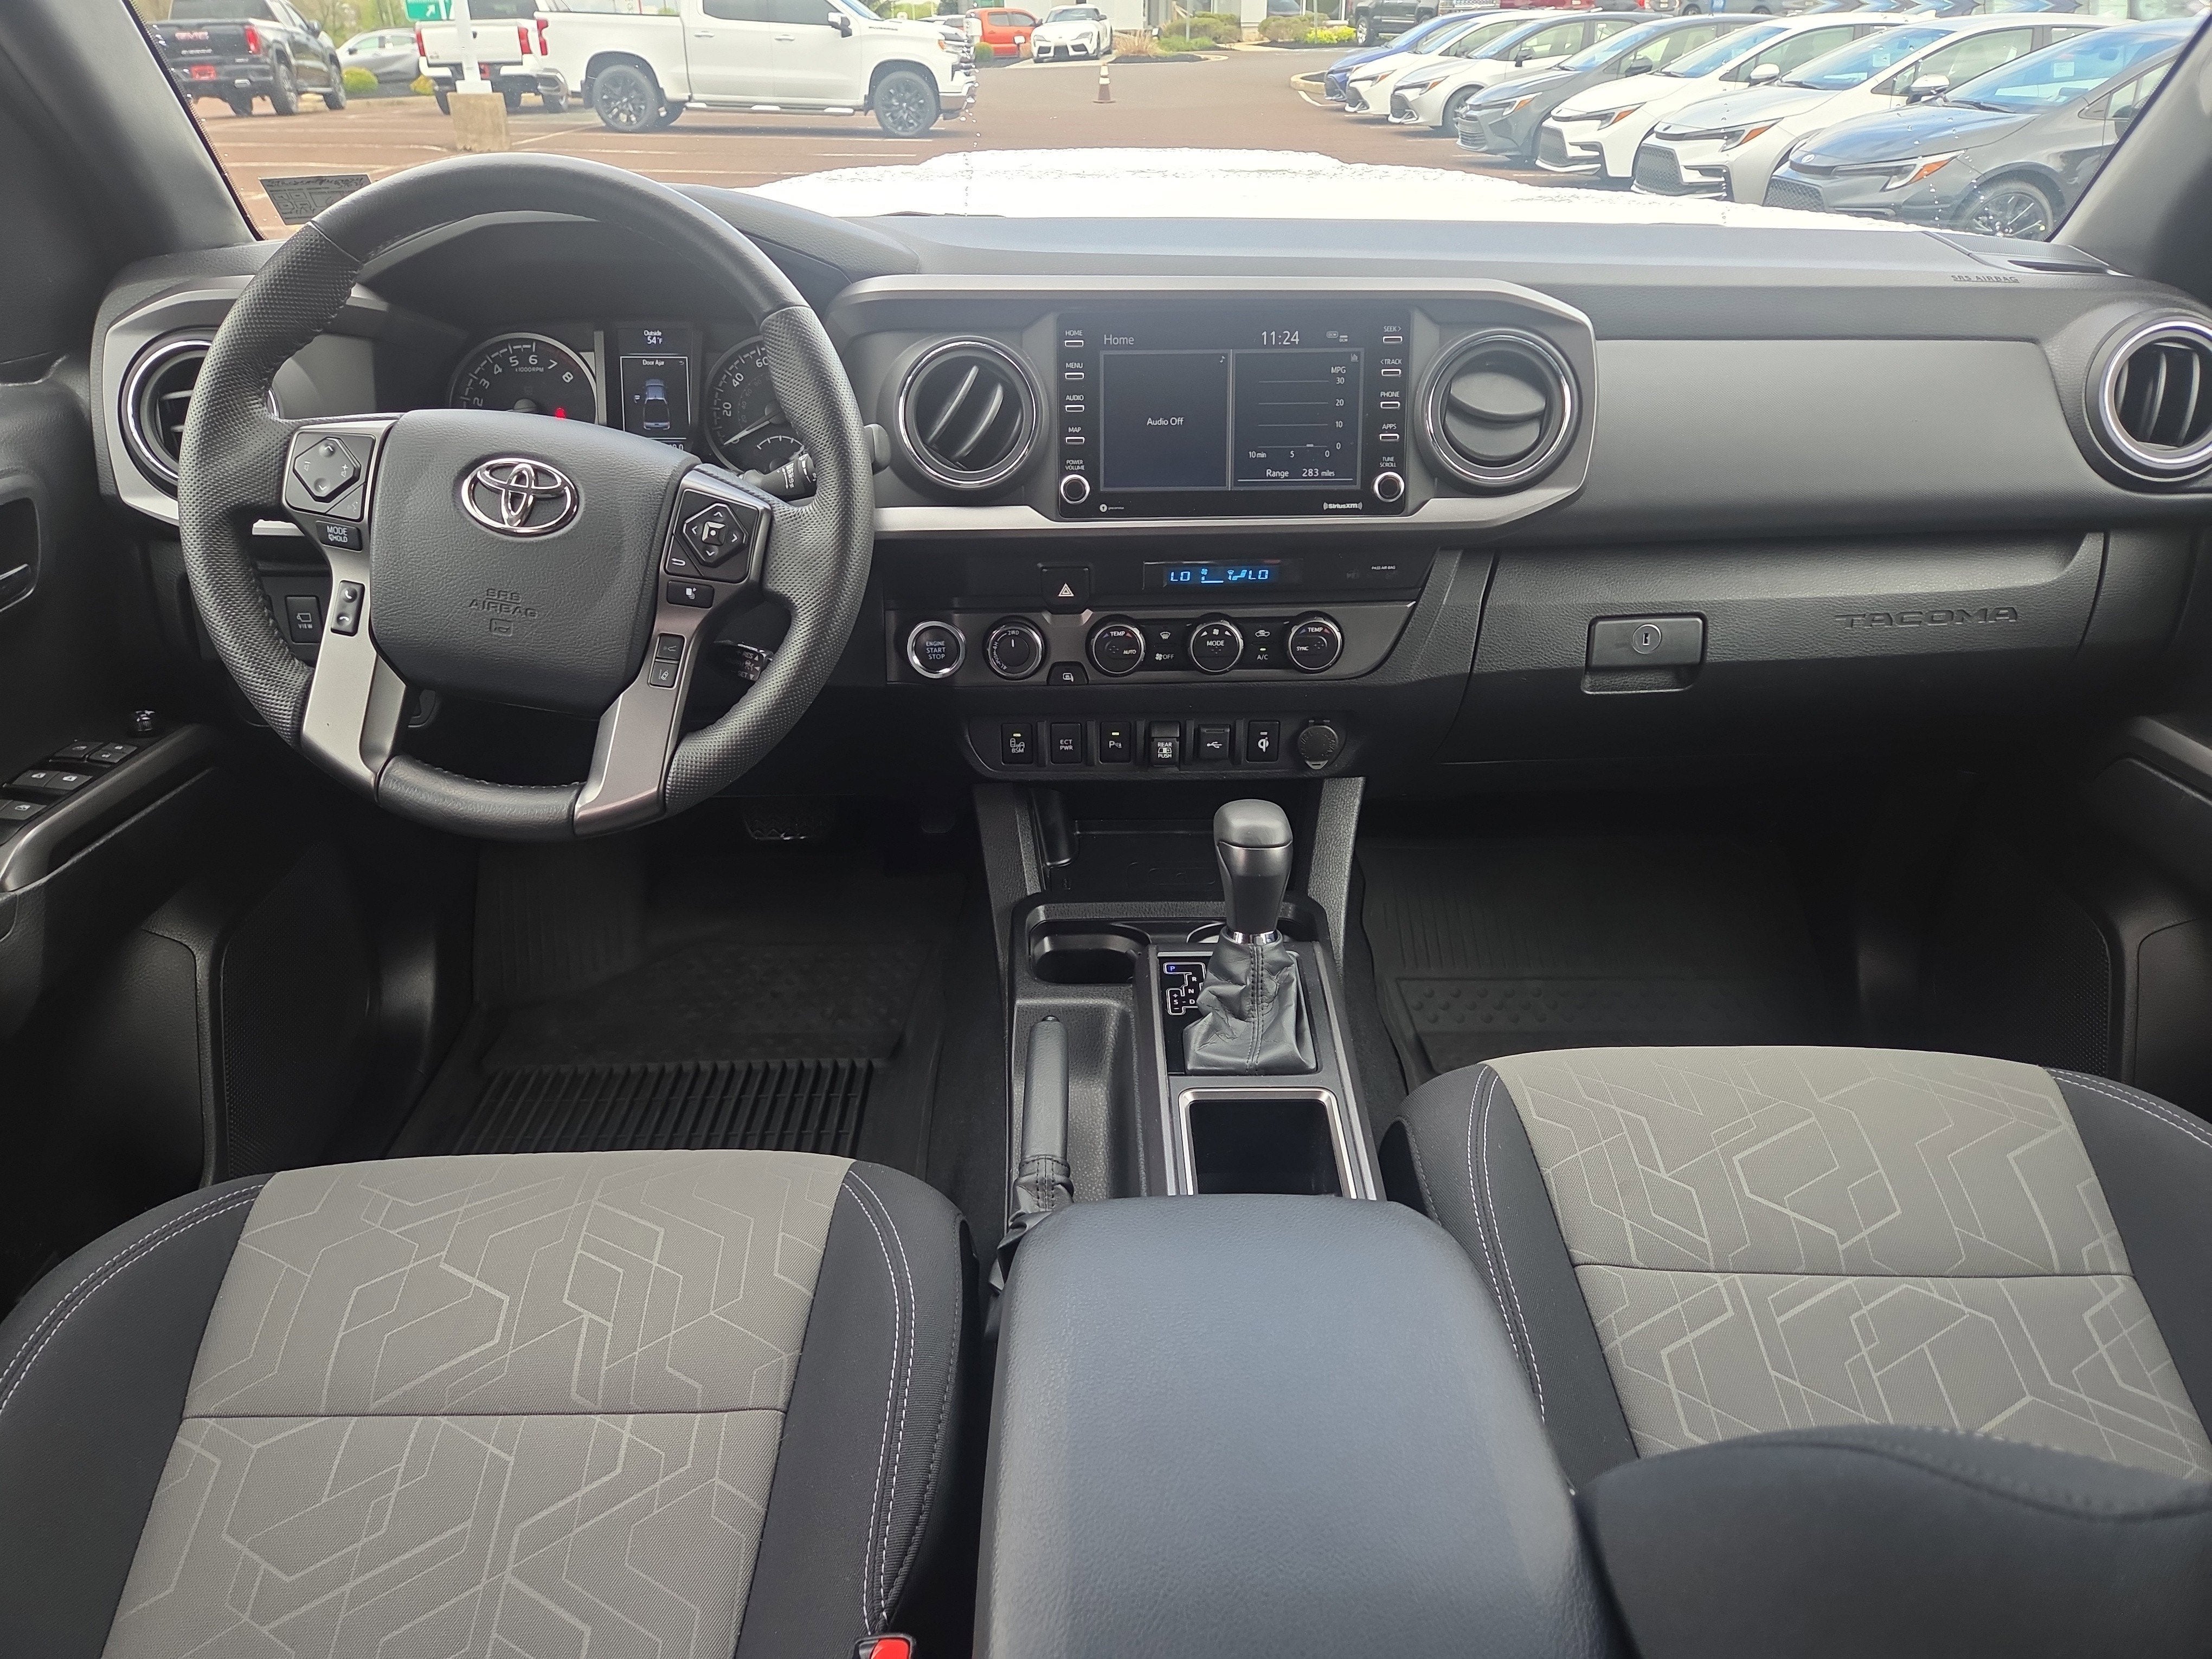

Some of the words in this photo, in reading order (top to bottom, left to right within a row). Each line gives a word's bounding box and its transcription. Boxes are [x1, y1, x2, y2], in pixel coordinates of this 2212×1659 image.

[1104, 334, 1135, 345] Home
[1262, 330, 1300, 345] 11:24
[509, 356, 519, 367] 5
[528, 355, 538, 365] 6
[548, 359, 558, 370] 7
[493, 363, 503, 375] 4
[1331, 366, 1346, 374] MPG
[562, 371, 574, 383] 8
[732, 372, 744, 388] 40
[1335, 398, 1344, 407] 20
[722, 401, 732, 417] 20
[1147, 417, 1168, 426] Audio
[1169, 417, 1184, 426] Off
[1336, 442, 1341, 450] 0
[1249, 451, 1256, 459] 10
[1290, 450, 1295, 458] 5
[1325, 449, 1330, 458] 0
[1266, 468, 1289, 479] Range
[1302, 468, 1319, 478] 283
[326, 525, 348, 536] MODE
[468, 599, 539, 620] AIRBAG
[1834, 606, 2018, 630] TACOMA
